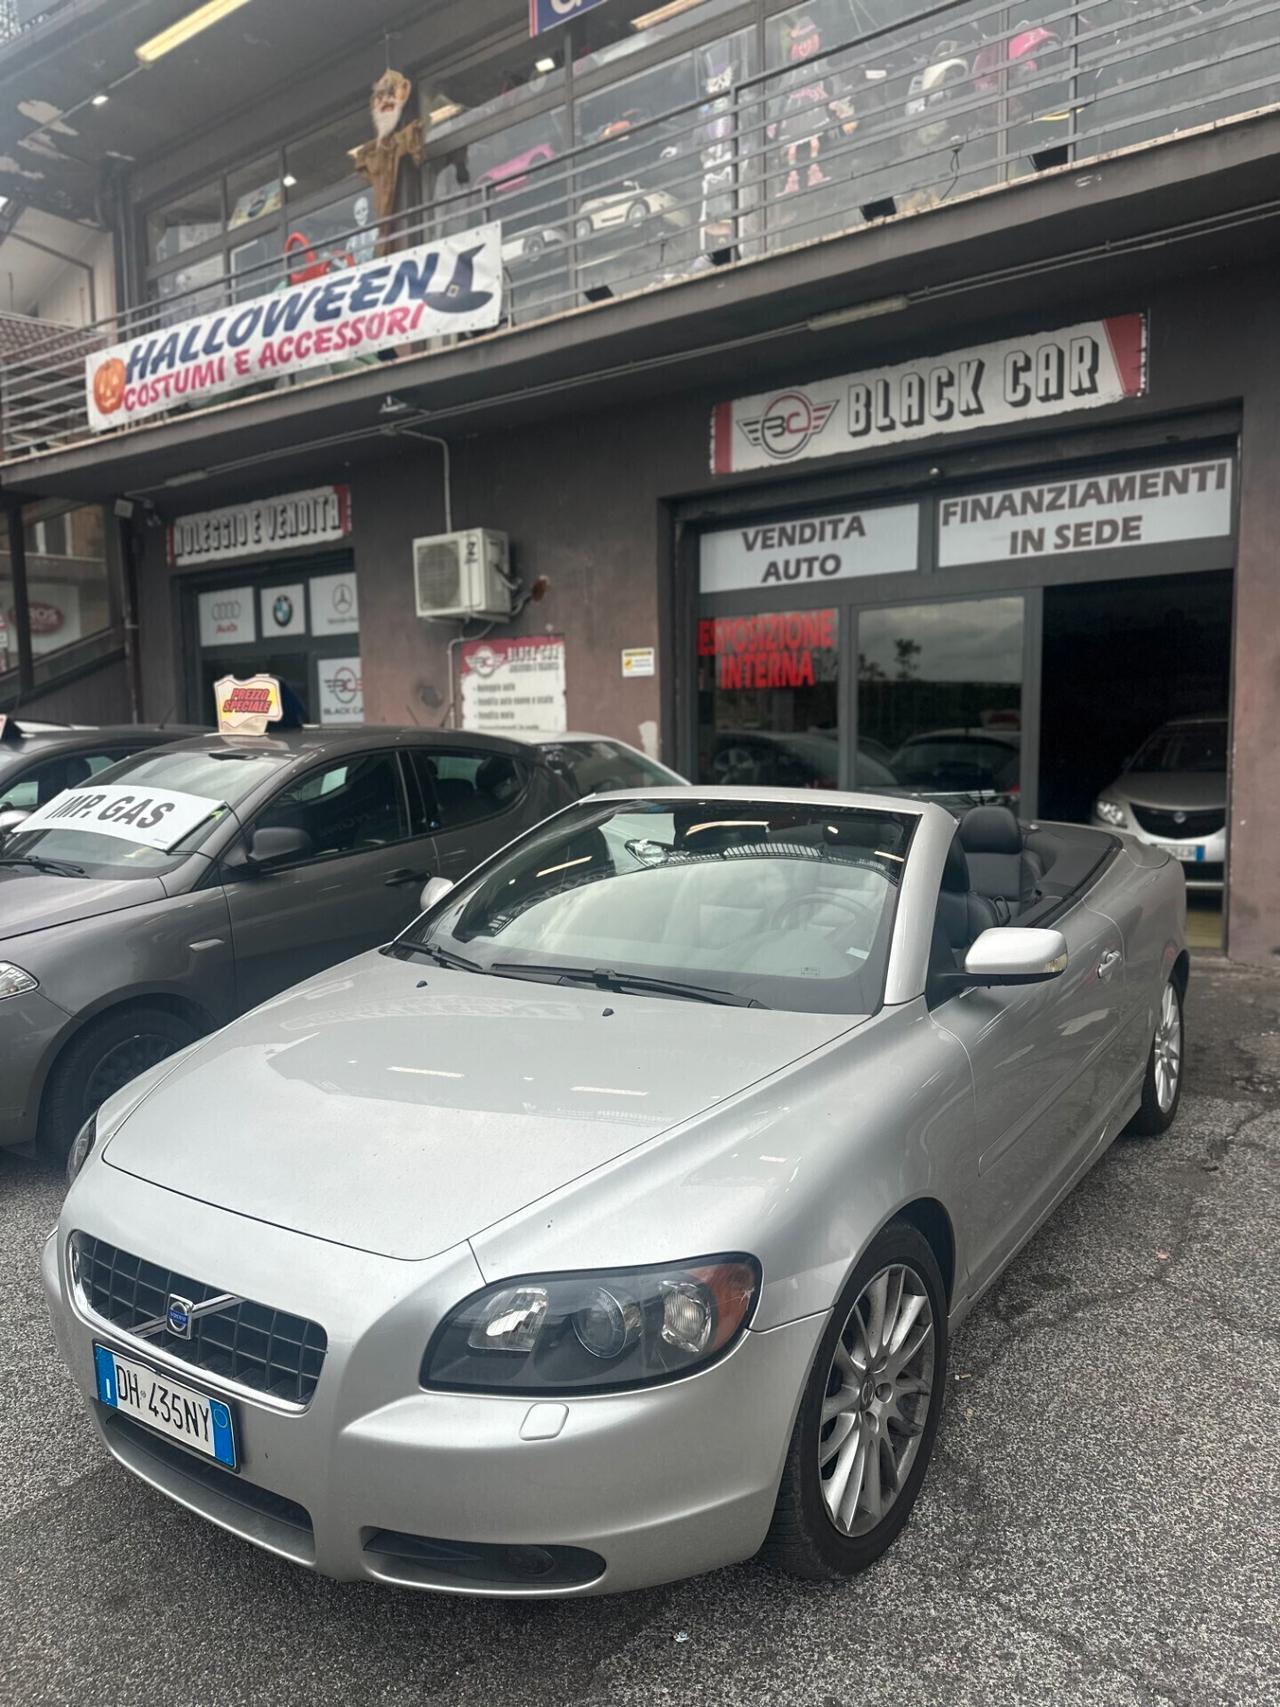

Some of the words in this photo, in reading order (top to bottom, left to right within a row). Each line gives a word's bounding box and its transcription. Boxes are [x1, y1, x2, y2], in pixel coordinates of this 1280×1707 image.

[125, 251, 440, 384] HALLOWEEN
[123, 353, 227, 412] COSTUMI
[235, 347, 251, 376] E
[258, 303, 427, 367] ACCESSORI
[847, 357, 985, 437] BLACK
[1003, 335, 1099, 405] CAR
[941, 461, 1228, 527] FINANZIAMENTI
[253, 508, 262, 544] E
[268, 493, 341, 542] VENDITA
[741, 515, 867, 552] VENDITA
[1009, 529, 1045, 555] IN
[1055, 516, 1143, 550] SEDE
[761, 554, 843, 584] AUTO
[699, 609, 834, 656] ESPOSIZIONE
[719, 649, 816, 690] INTERNA
[223, 699, 272, 714] SPECIALE
[231, 688, 270, 700] PREZZO
[44, 794, 103, 820] IMP.
[97, 795, 176, 829] GAS
[116, 1364, 140, 1409] DH
[148, 1382, 210, 1441] 435NY
